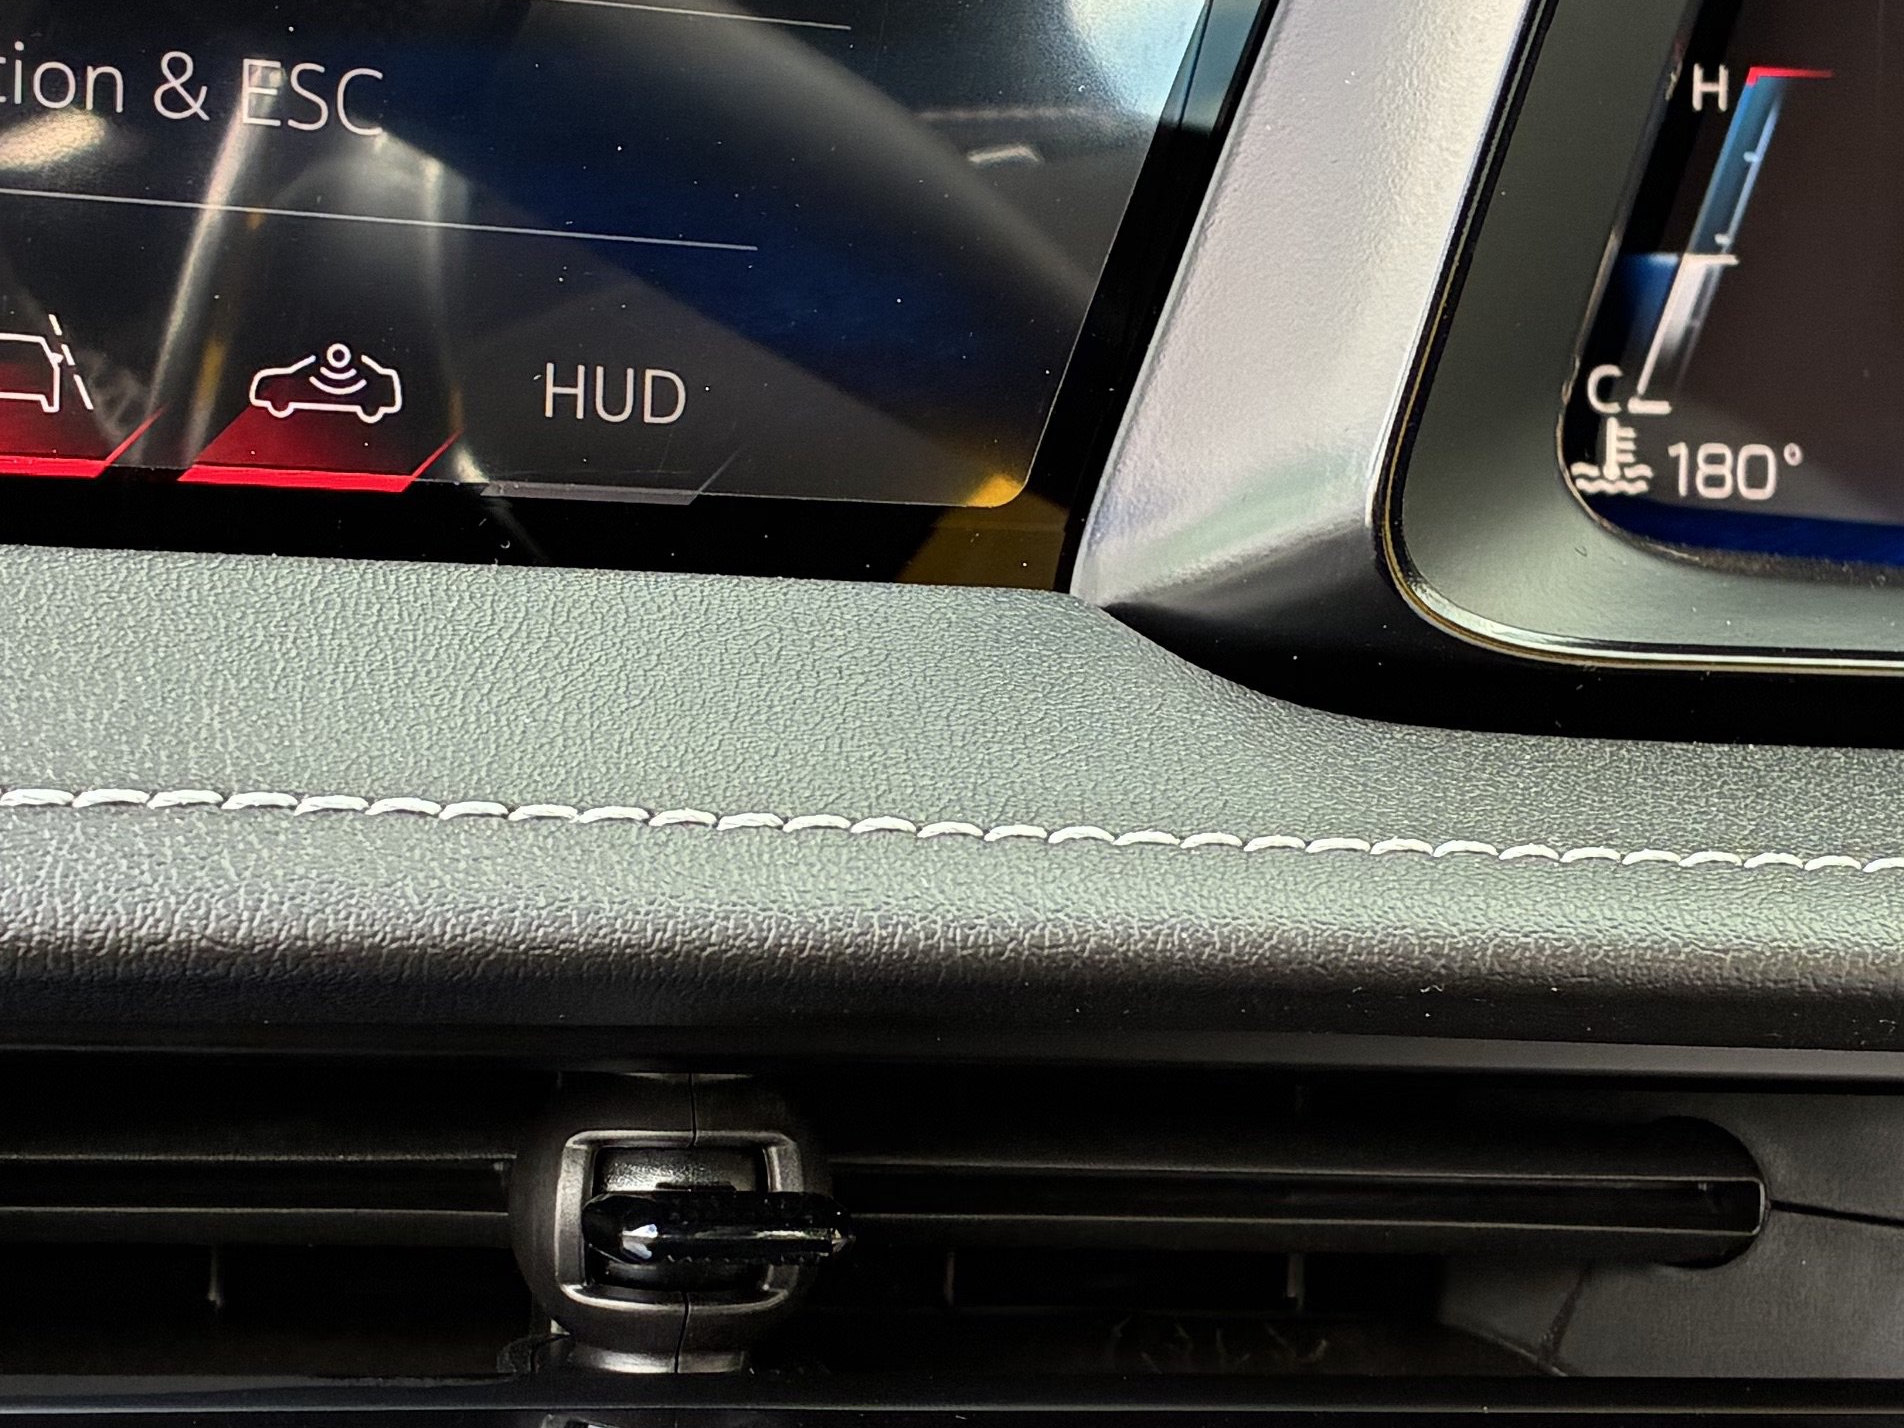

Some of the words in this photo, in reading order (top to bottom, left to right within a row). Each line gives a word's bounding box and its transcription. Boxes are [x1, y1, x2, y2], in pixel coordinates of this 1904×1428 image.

[152, 50, 212, 124] &
[242, 57, 387, 140] ESC
[1691, 62, 1730, 113] H
[543, 360, 688, 427] HUD
[1586, 363, 1624, 415] C
[1666, 440, 1804, 502] 180°
